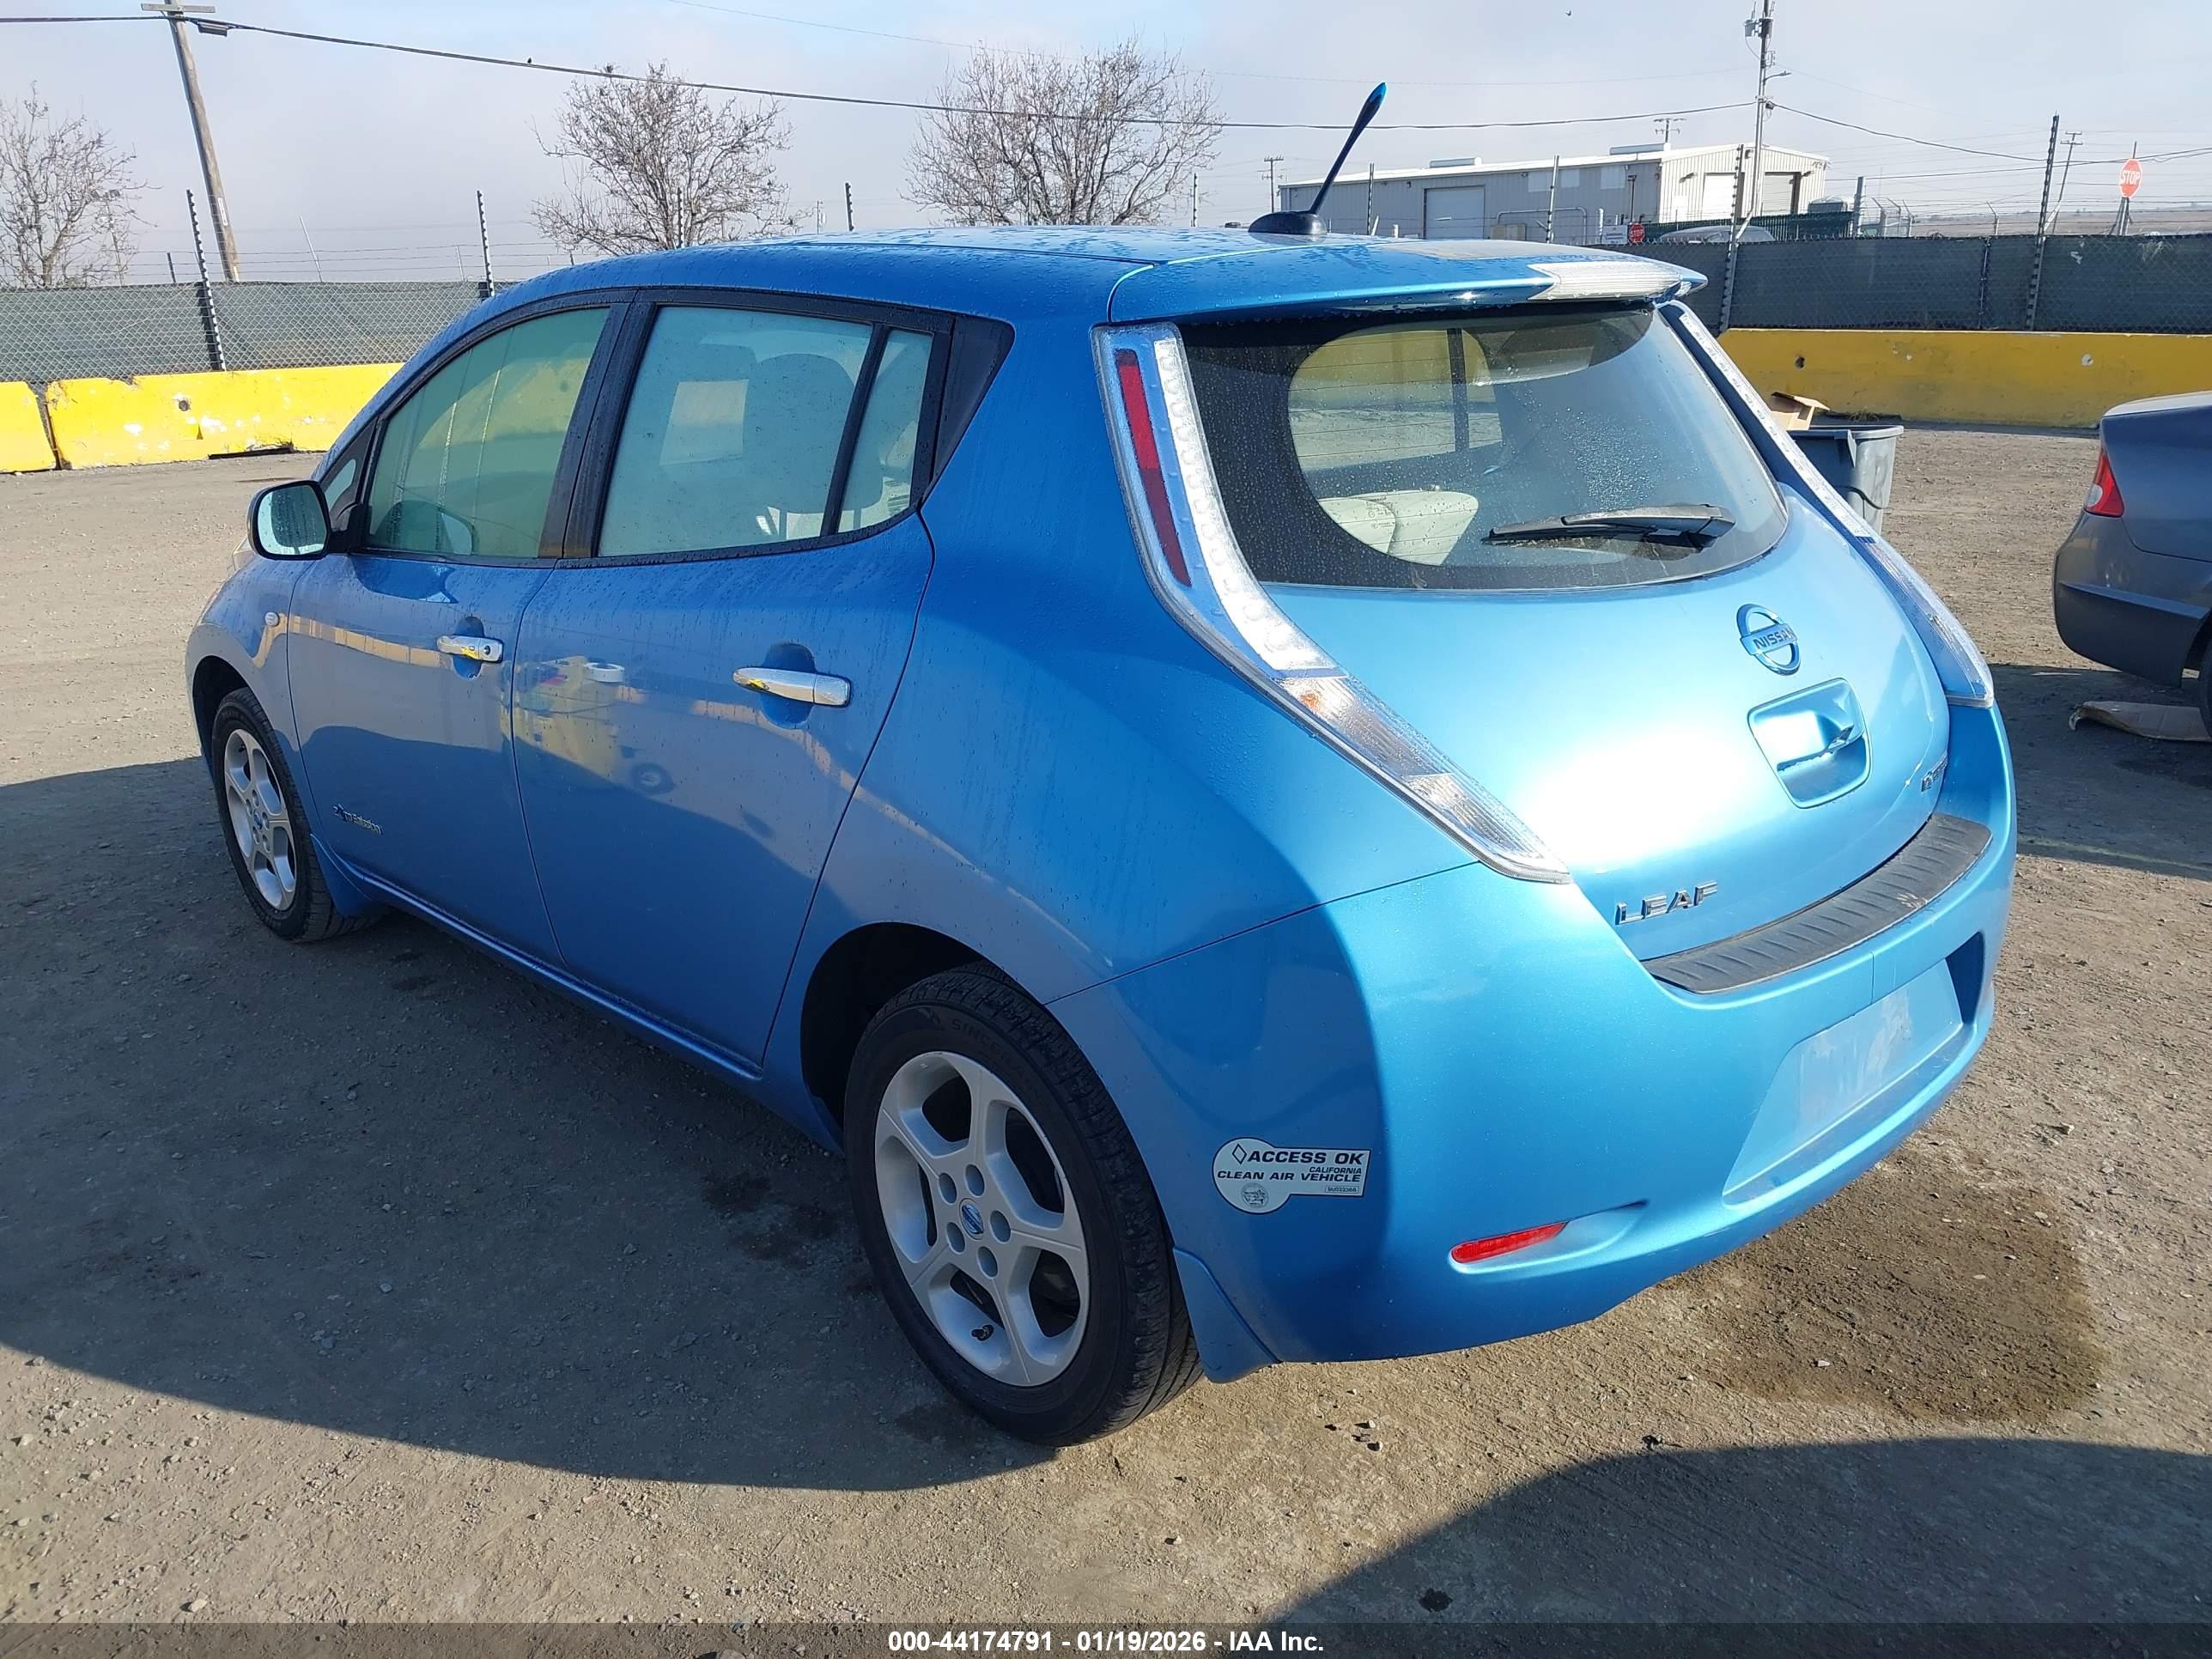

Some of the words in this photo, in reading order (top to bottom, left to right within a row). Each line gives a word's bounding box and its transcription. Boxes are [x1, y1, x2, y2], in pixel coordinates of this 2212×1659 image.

[2121, 170, 2141, 185] STOP
[1630, 228, 1644, 238] STOP
[1752, 627, 1796, 650] NISSAN
[1614, 879, 1718, 926] LEAF
[1247, 1150, 1328, 1164] ACCESS
[1334, 1152, 1364, 1165] OK
[1217, 1170, 1265, 1180] CLEAN
[1269, 1171, 1295, 1181] AIR
[1300, 1172, 1362, 1182] VEHICLE
[1309, 1166, 1362, 1175] CALIFORNIA
